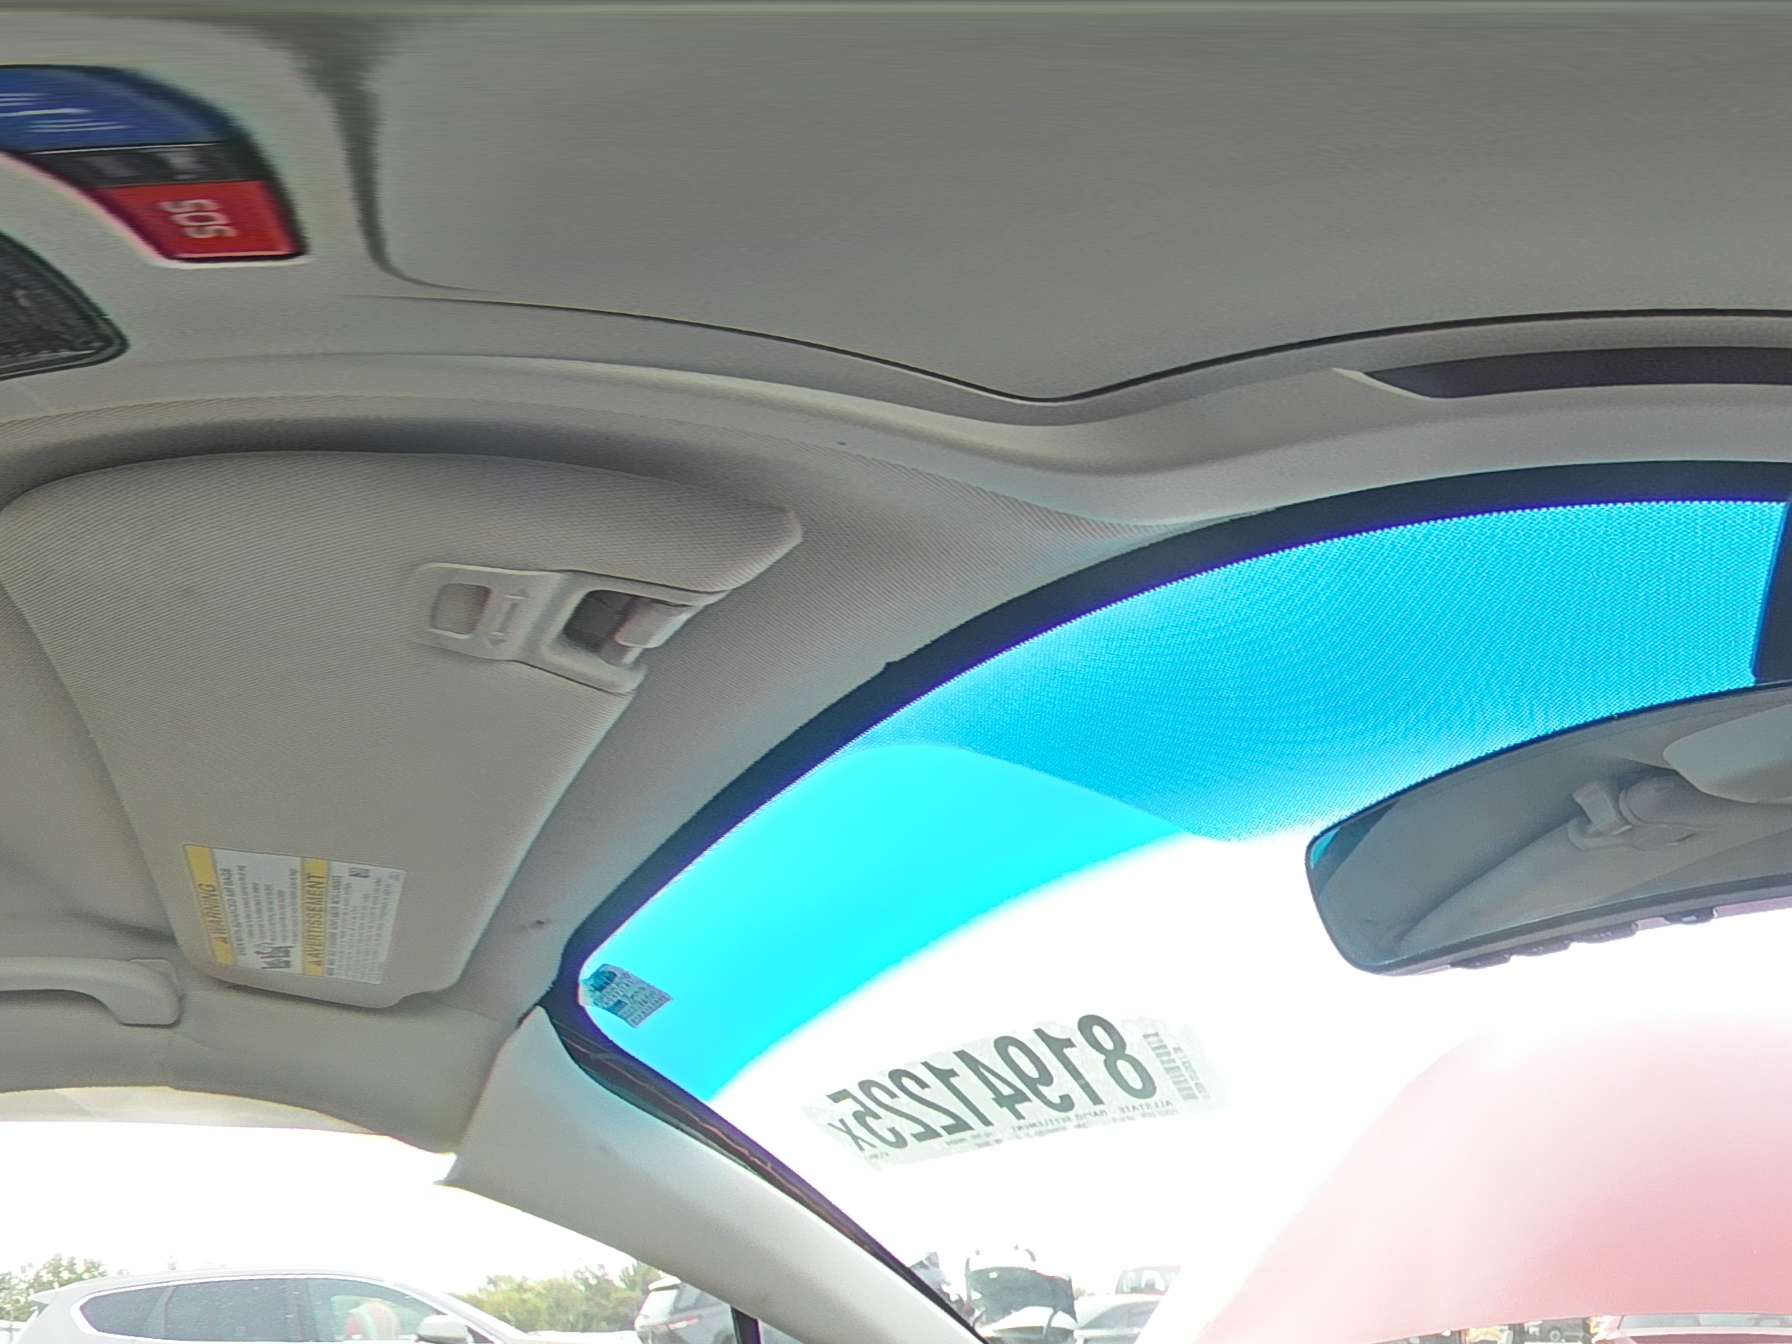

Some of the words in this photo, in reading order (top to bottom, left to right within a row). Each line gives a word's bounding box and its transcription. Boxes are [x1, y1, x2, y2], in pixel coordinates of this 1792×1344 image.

[158, 199, 237, 239] SOS
[198, 883, 228, 936] WARNING
[306, 873, 325, 957] AVERTISSEMENT
